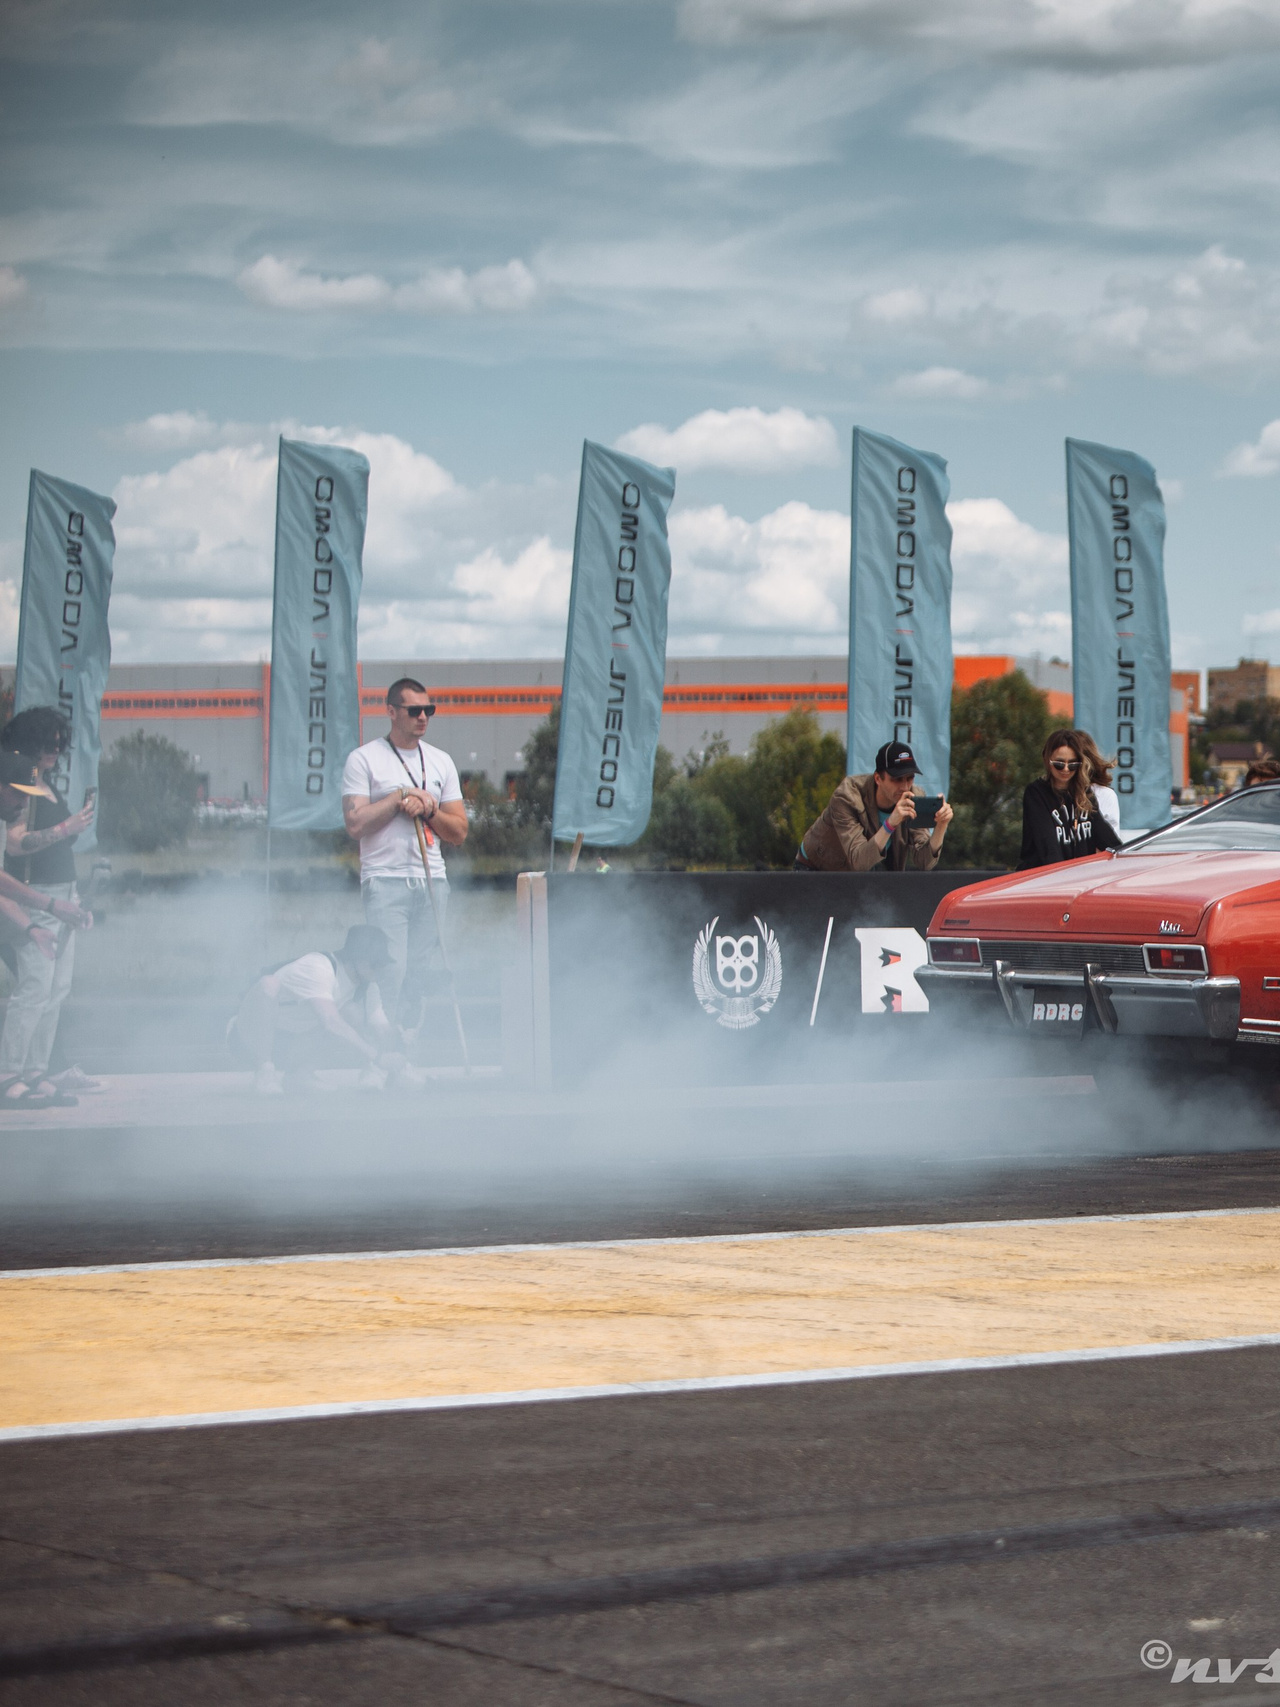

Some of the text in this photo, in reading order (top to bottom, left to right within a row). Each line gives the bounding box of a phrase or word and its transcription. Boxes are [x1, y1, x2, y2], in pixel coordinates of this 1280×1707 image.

[60, 511, 85, 655] OMODA
[896, 466, 917, 617] OMODA
[306, 475, 334, 795] OMODA JAECOO
[596, 481, 641, 809] OMODA JAECOO
[894, 644, 914, 744] JAEC
[1110, 474, 1136, 794] OMODA JAECOO
[1033, 1003, 1083, 1021] RDRC
